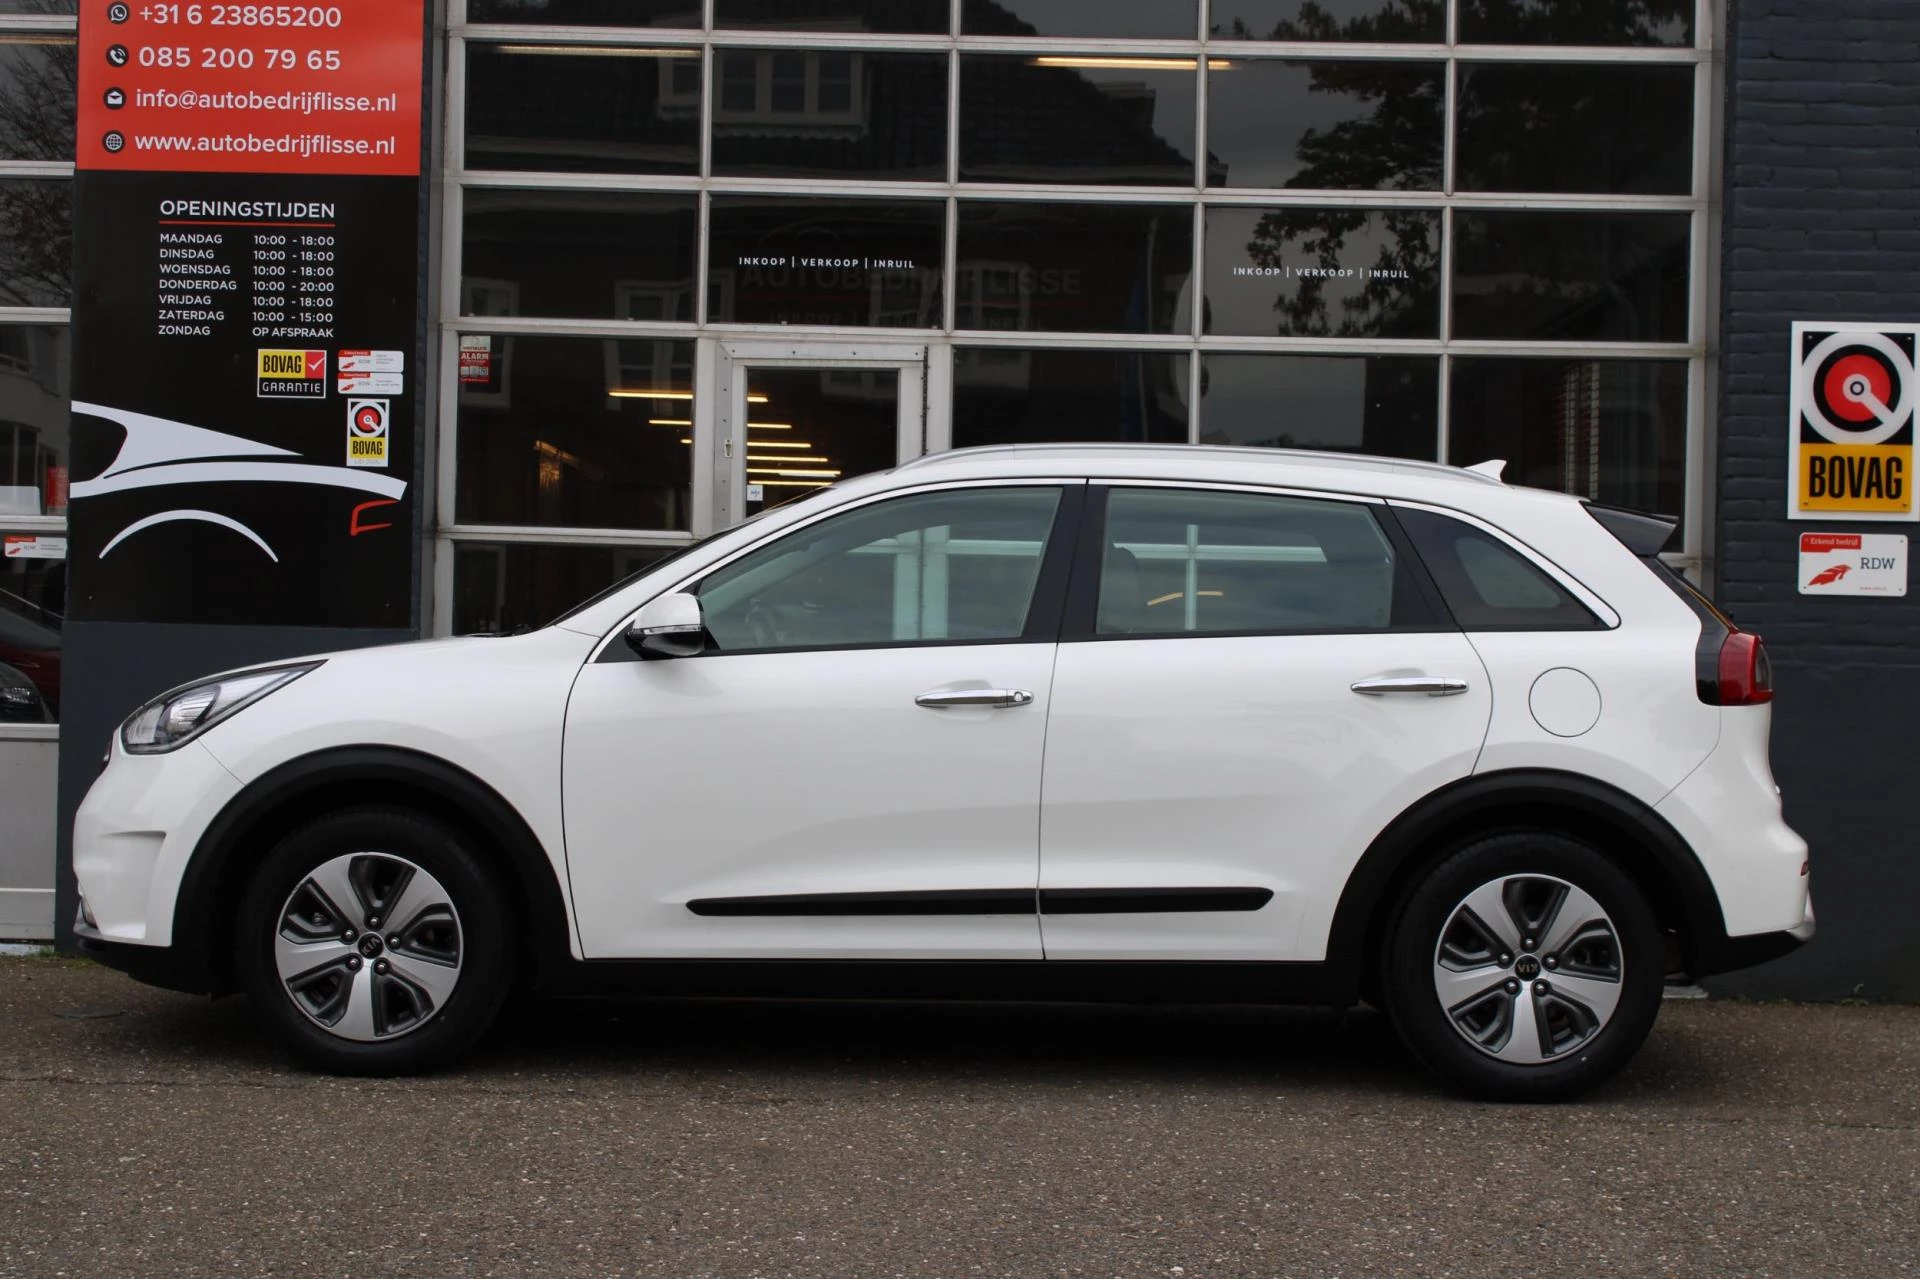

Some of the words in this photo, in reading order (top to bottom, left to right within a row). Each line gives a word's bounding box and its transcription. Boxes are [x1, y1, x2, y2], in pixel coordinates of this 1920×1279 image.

[139, 4, 179, 24] +31
[187, 5, 203, 24] 6
[210, 5, 342, 27] 23865200
[138, 47, 191, 67] 085
[201, 48, 254, 68] 200
[264, 49, 296, 69] 79
[306, 50, 341, 70] 65
[136, 89, 397, 114] info@autobedrijflisse.nl
[135, 133, 396, 157] www.autobedrijflisse.nl
[160, 200, 335, 218] OPENINGSTIJDEN
[159, 234, 223, 244] MAANDAG
[254, 235, 286, 245] 10:00
[301, 236, 335, 246] 18:00
[159, 249, 214, 259] DINSDAG
[254, 250, 286, 260] 10:00
[300, 252, 334, 261] 18:00
[739, 257, 786, 266] INKOOP
[801, 258, 860, 266] VERKOOP
[874, 260, 915, 268] INRUIL
[159, 264, 231, 274] WOENSDAG
[254, 266, 286, 276] 10:00
[300, 267, 334, 276] 18:00
[1233, 268, 1281, 276] INKOOP
[1296, 268, 1354, 277] VERKOOP
[1368, 270, 1410, 278] INRUIL
[159, 280, 237, 290] DONDERDAG
[254, 282, 286, 291] 10:00
[300, 282, 334, 292] 20:00
[159, 294, 212, 304] VRIJDAG
[253, 296, 285, 306] 10:00
[300, 298, 334, 307] 18:00
[158, 310, 224, 320] ZATERDAG
[252, 312, 284, 322] 10:00
[300, 312, 333, 322] 15:00
[158, 325, 210, 335] ZONDAG
[252, 327, 270, 336] OP
[272, 328, 334, 338] AFSPRAAK
[263, 355, 302, 374] BOVAG
[262, 382, 321, 392] GARANTIE
[352, 440, 382, 455] BOVAG
[1809, 456, 1903, 500] BOVAG
[1860, 557, 1896, 570] RDW
